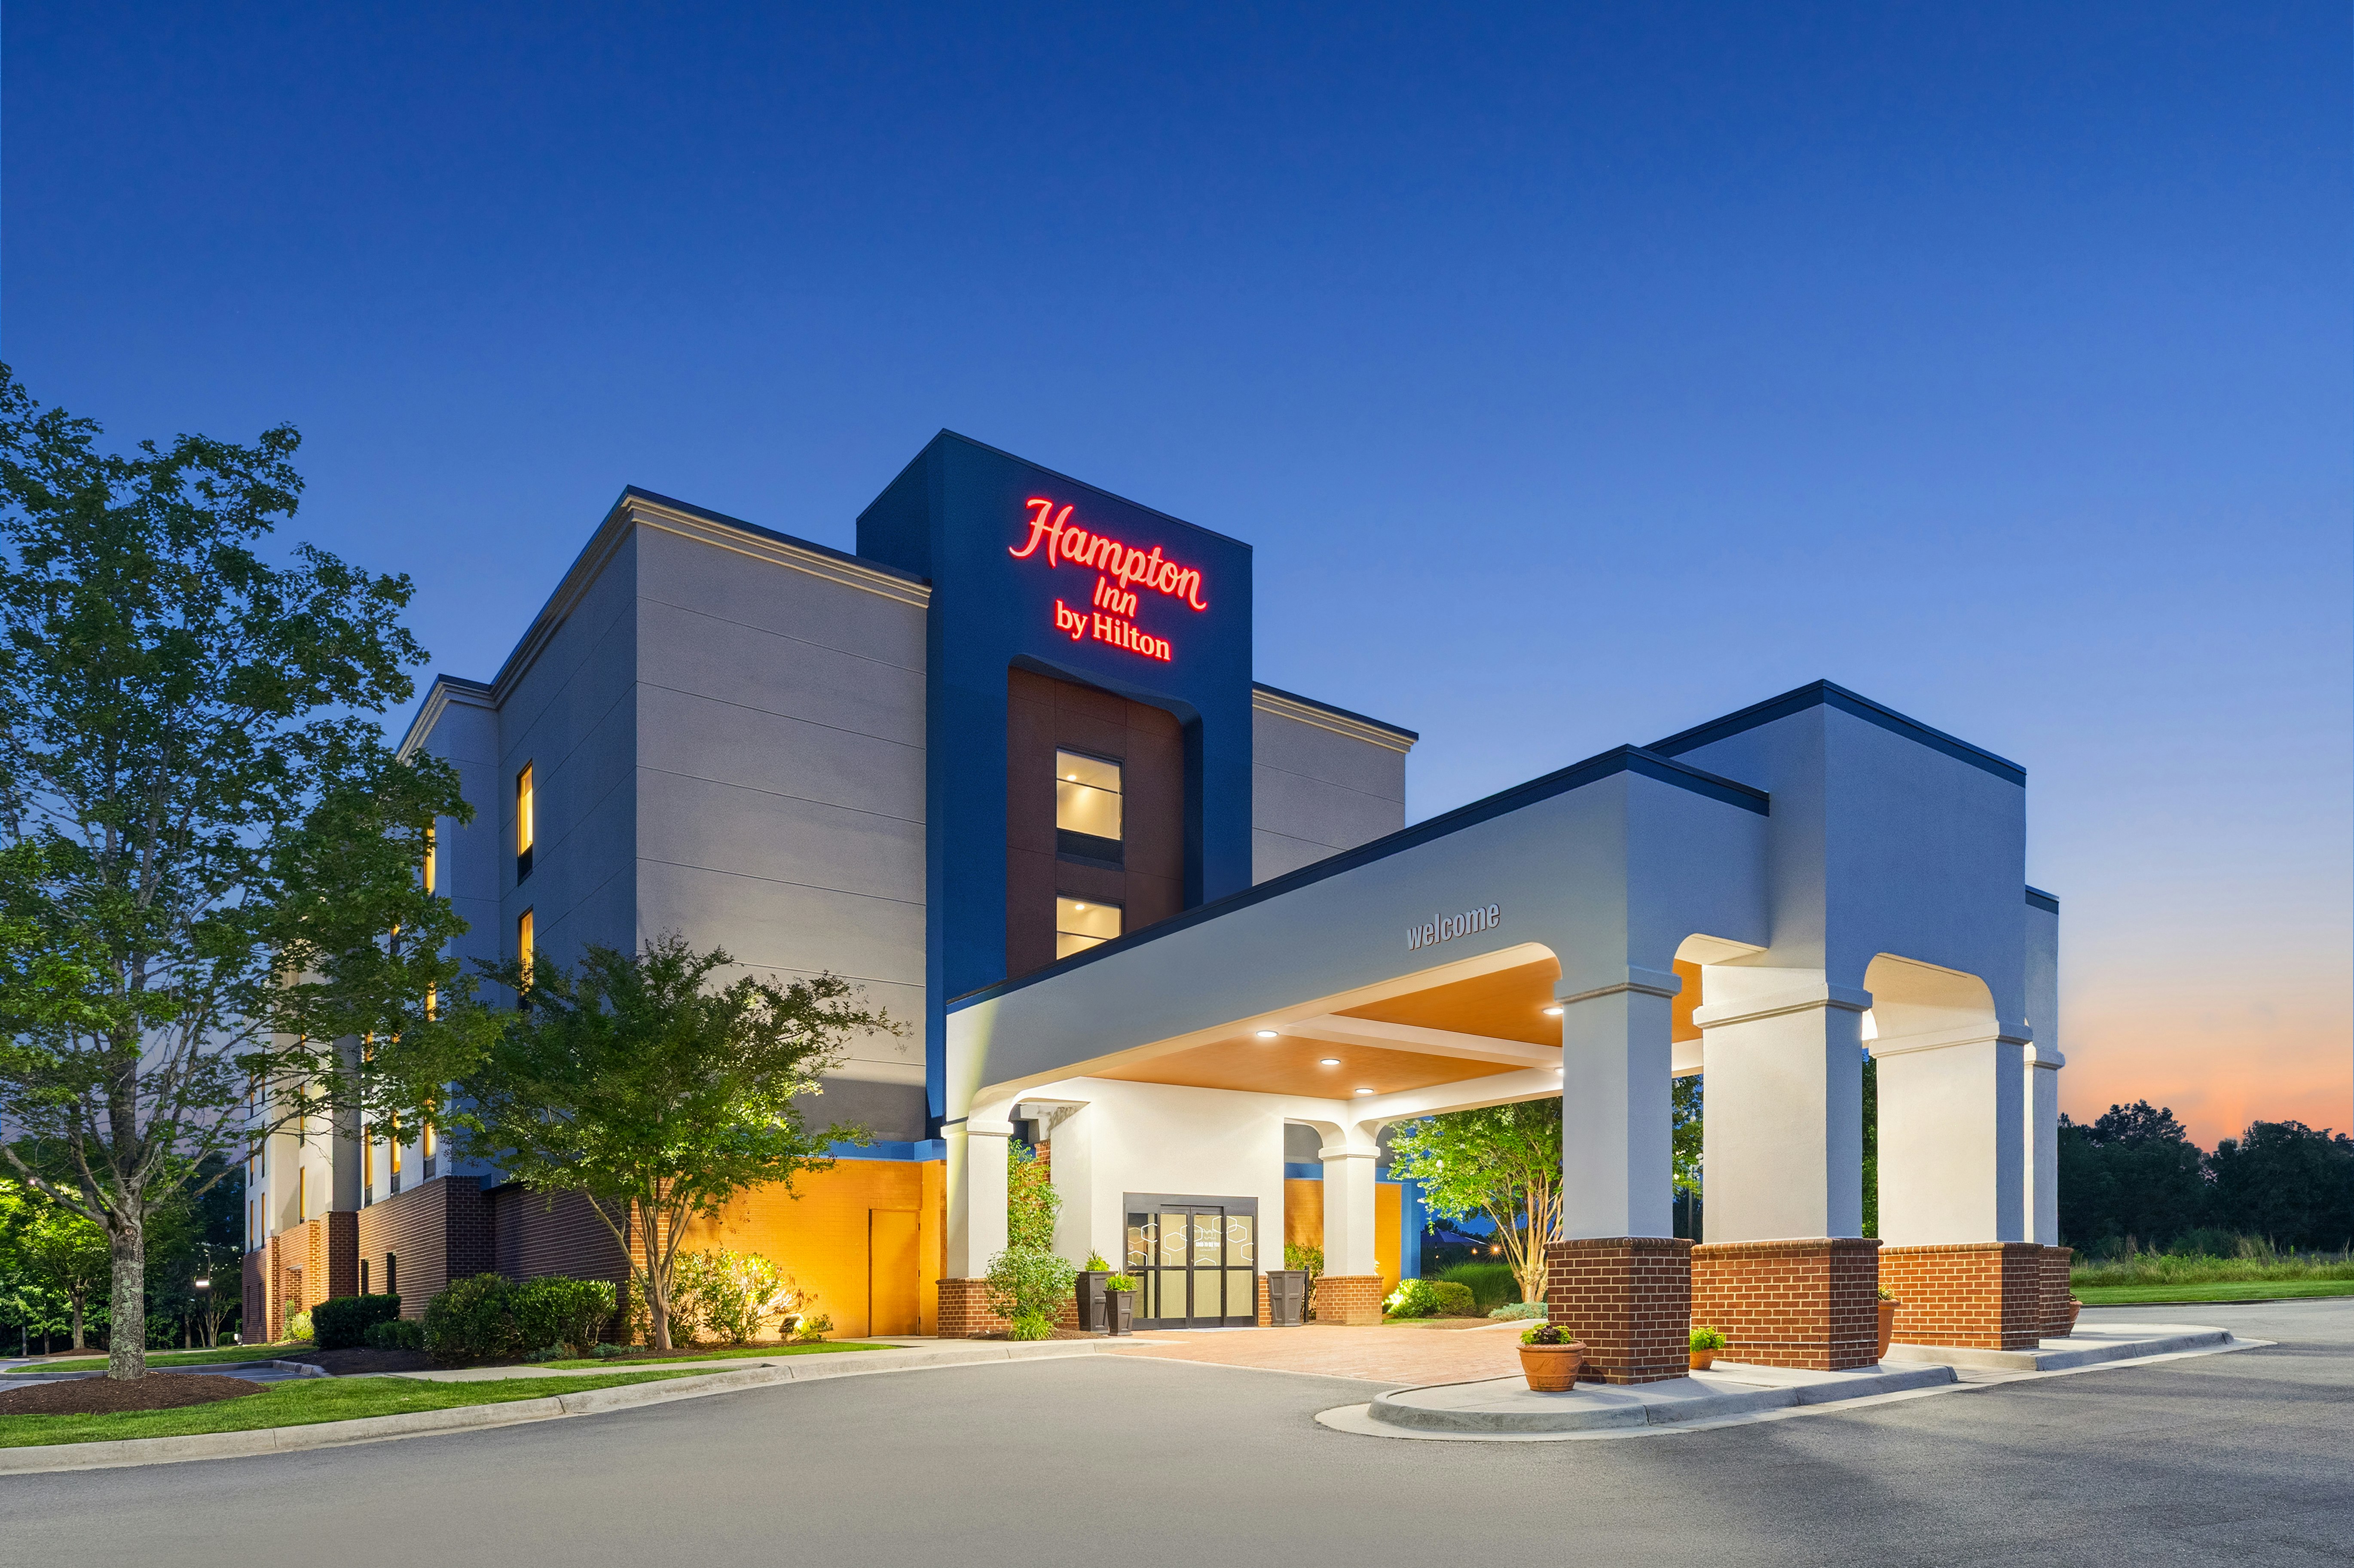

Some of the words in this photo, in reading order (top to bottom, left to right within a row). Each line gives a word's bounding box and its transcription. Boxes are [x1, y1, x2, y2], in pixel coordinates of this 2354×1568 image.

[1009, 498, 1207, 610] Hampton
[1094, 576, 1137, 617] Inn
[1055, 600, 1088, 640] by
[1092, 612, 1171, 661] Hilton
[1406, 903, 1500, 951] welcome
